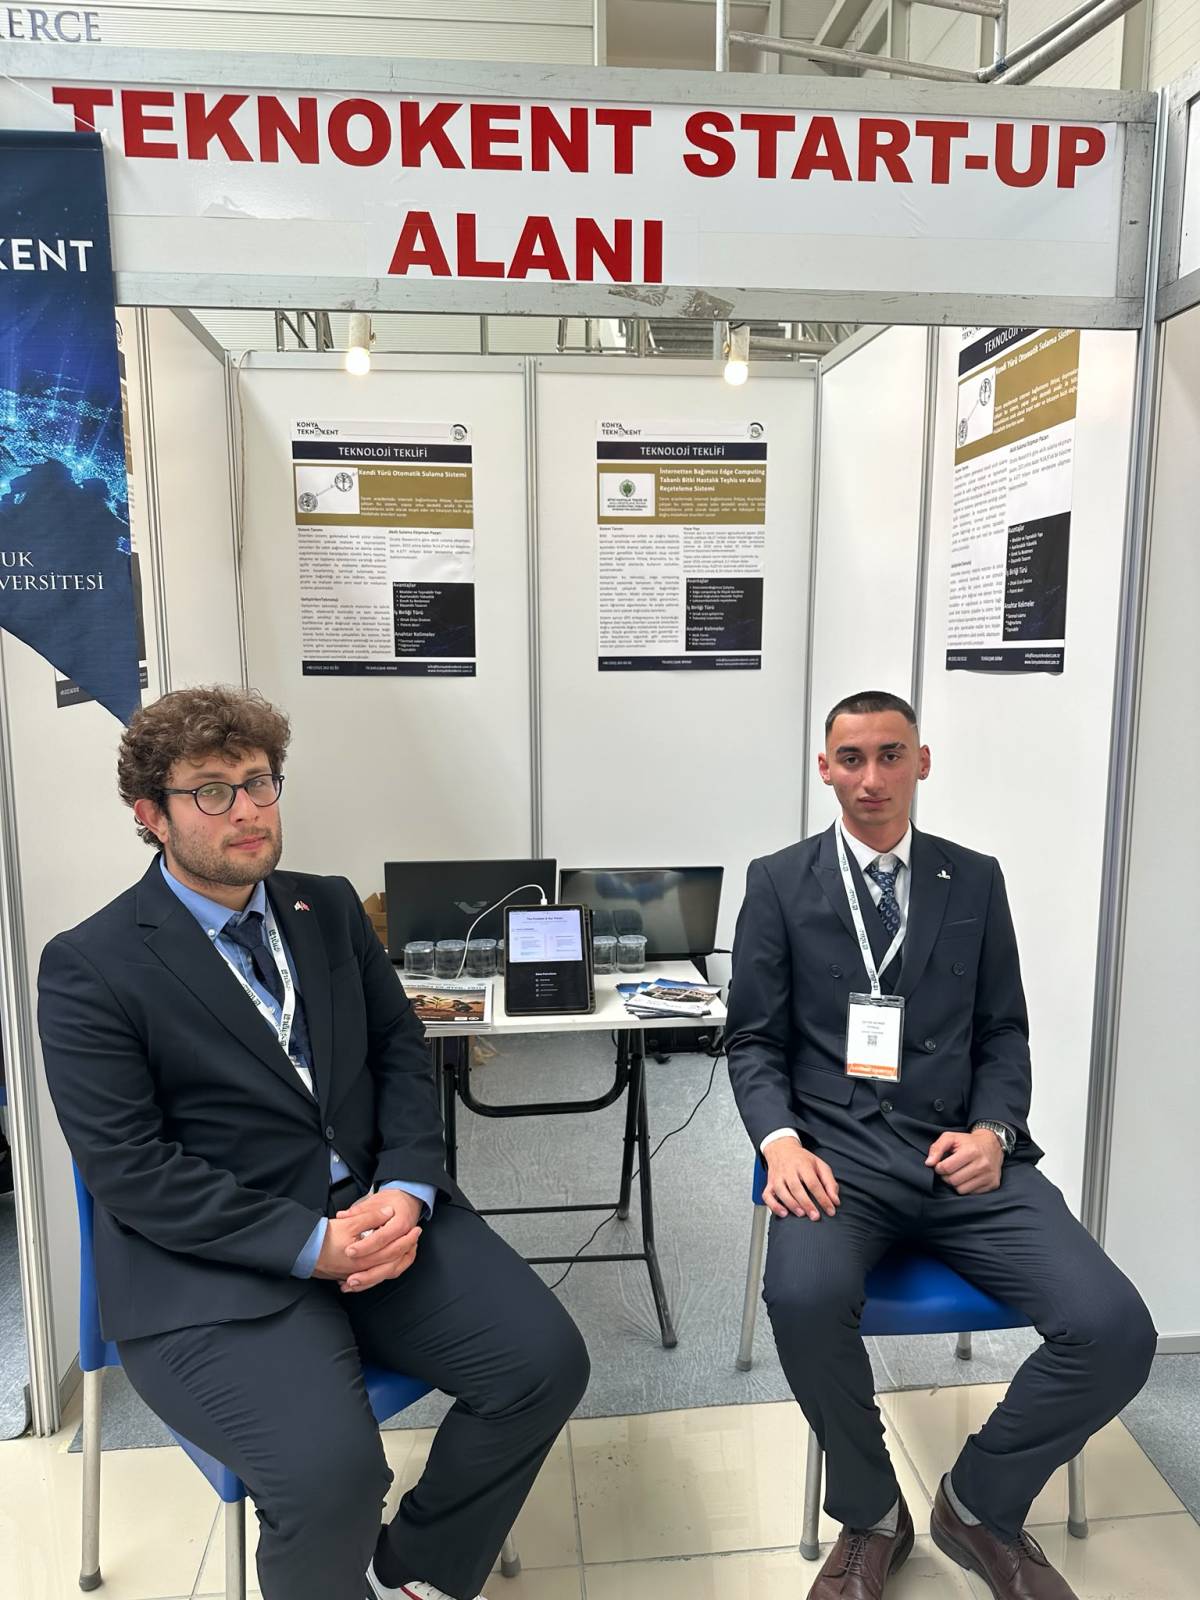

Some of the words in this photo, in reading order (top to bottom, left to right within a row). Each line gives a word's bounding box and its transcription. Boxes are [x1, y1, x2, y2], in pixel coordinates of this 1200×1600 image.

[0, 8, 101, 42] ERCE
[52, 86, 652, 174] TEKNOKENT
[683, 111, 1106, 188] START-UP
[388, 210, 663, 284] ALANI
[338, 446, 391, 457] TEKNOLOJİ
[393, 447, 428, 458] TEKLİFİ
[640, 445, 691, 456] TEKNOLOJİ
[693, 445, 725, 456] TEKLİFİ
